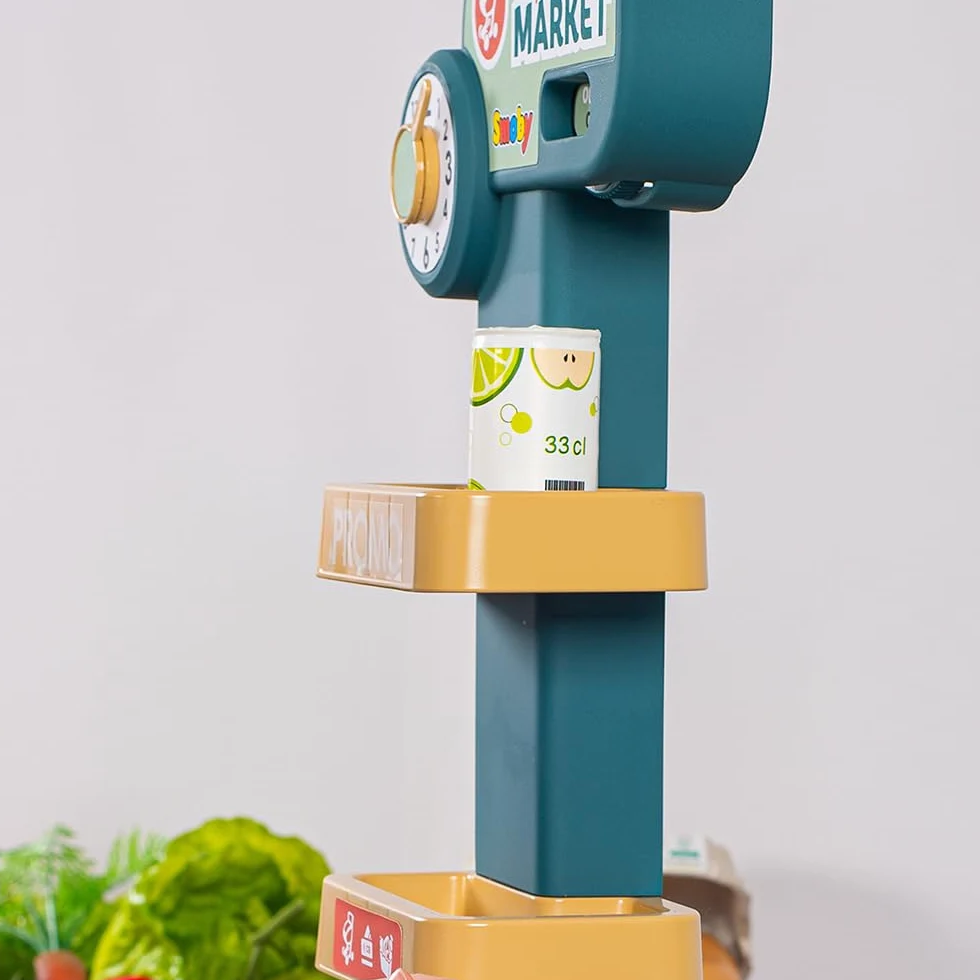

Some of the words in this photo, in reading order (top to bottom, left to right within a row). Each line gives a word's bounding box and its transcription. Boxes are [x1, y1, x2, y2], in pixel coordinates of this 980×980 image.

[514, 0, 604, 57] MARKET
[443, 119, 450, 141] 2
[493, 105, 533, 155] Smoby
[445, 150, 452, 186] 3
[423, 235, 430, 270] 6
